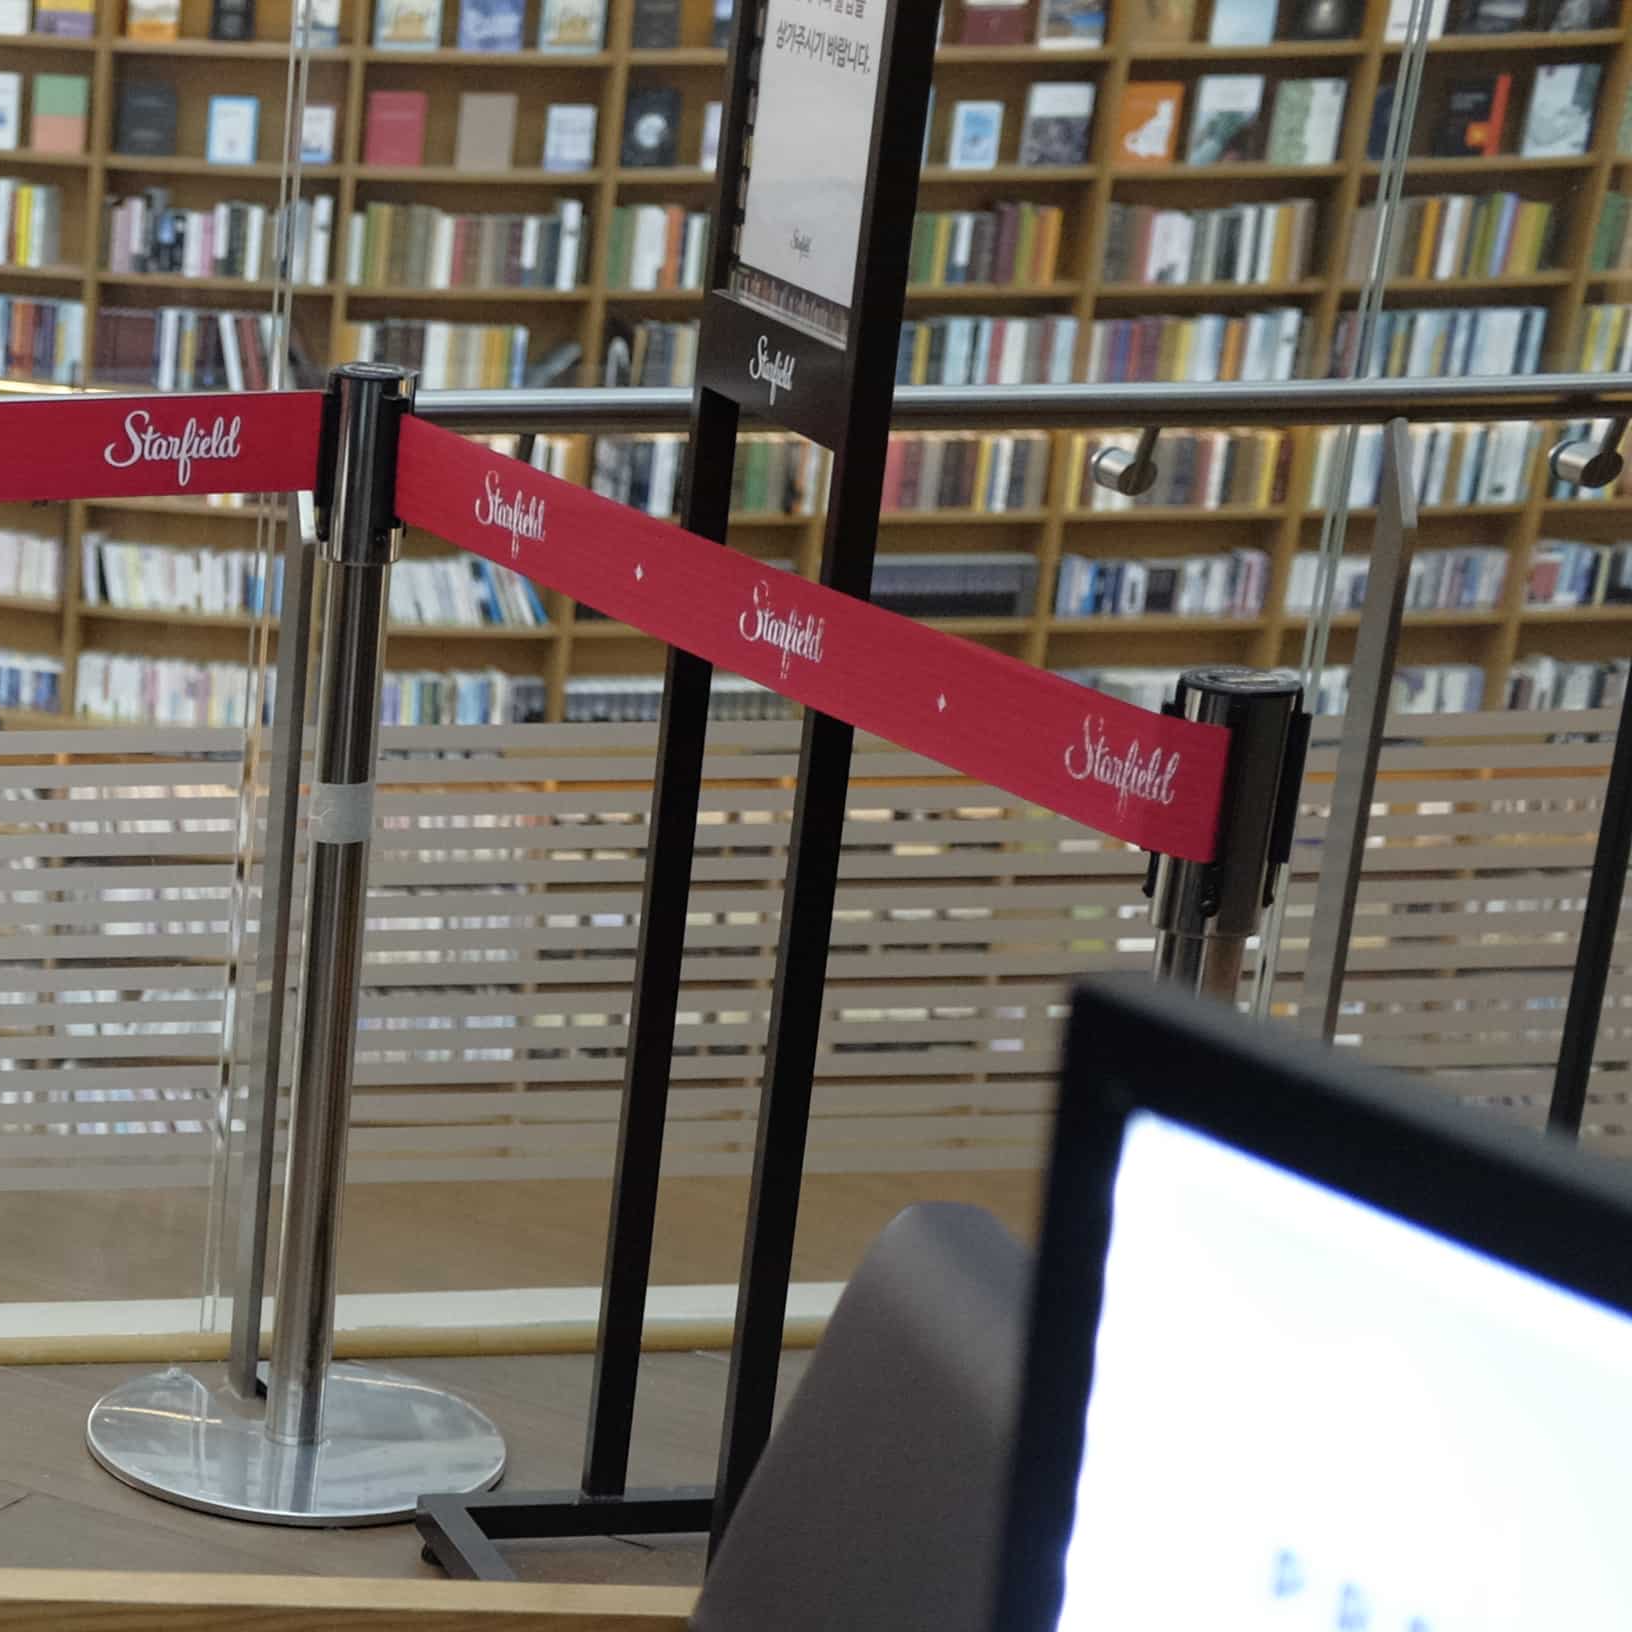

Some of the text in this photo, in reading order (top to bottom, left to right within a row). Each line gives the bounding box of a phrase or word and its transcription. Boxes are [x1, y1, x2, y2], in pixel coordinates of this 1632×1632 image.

[104, 410, 241, 487] Starfield
[474, 470, 546, 560] Starfield
[739, 579, 825, 679] Starfield
[1064, 713, 1180, 822] Starfield
